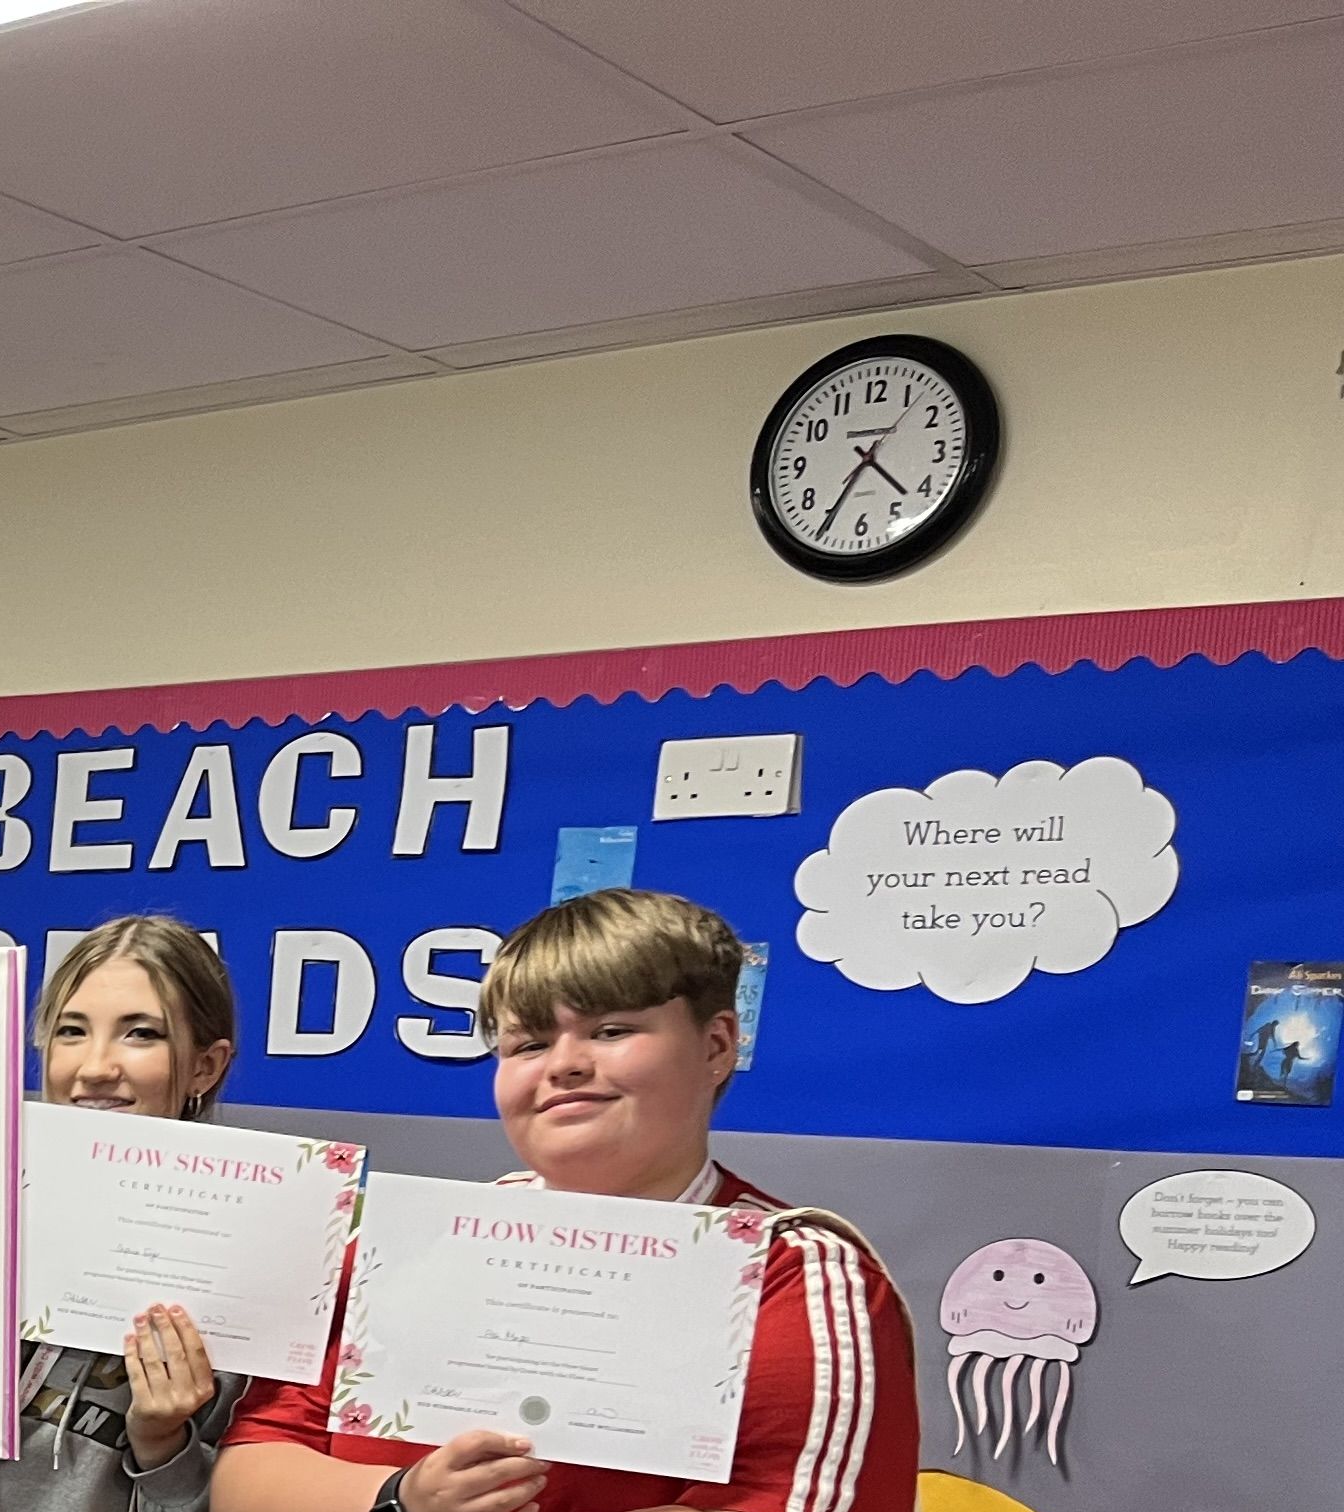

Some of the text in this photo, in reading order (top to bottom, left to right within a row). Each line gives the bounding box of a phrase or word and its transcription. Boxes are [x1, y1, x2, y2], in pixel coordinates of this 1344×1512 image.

[834, 392, 851, 416] 11
[865, 380, 887, 404] 12
[903, 385, 912, 407] 1
[924, 405, 939, 429] 2
[806, 418, 828, 443] 10
[932, 440, 946, 463] 3
[793, 456, 807, 480] 9
[917, 474, 932, 498] 4
[801, 487, 816, 510] 8
[854, 513, 868, 536] 6
[904, 816, 1064, 846] Where will
[866, 858, 1091, 897] your next read
[902, 902, 1045, 936] take you?
[91, 1140, 285, 1186] FLOW SISTERS
[119, 1179, 244, 1204] CERTIFICATE
[1154, 1191, 1184, 1203] Don't
[1188, 1193, 1224, 1207] forget
[1237, 1198, 1259, 1208] you
[1197, 1208, 1231, 1220] books
[451, 1215, 681, 1260] FLOW SISTERS
[1168, 1238, 1207, 1253] Happy
[486, 1257, 635, 1282] CERTIFICATE
